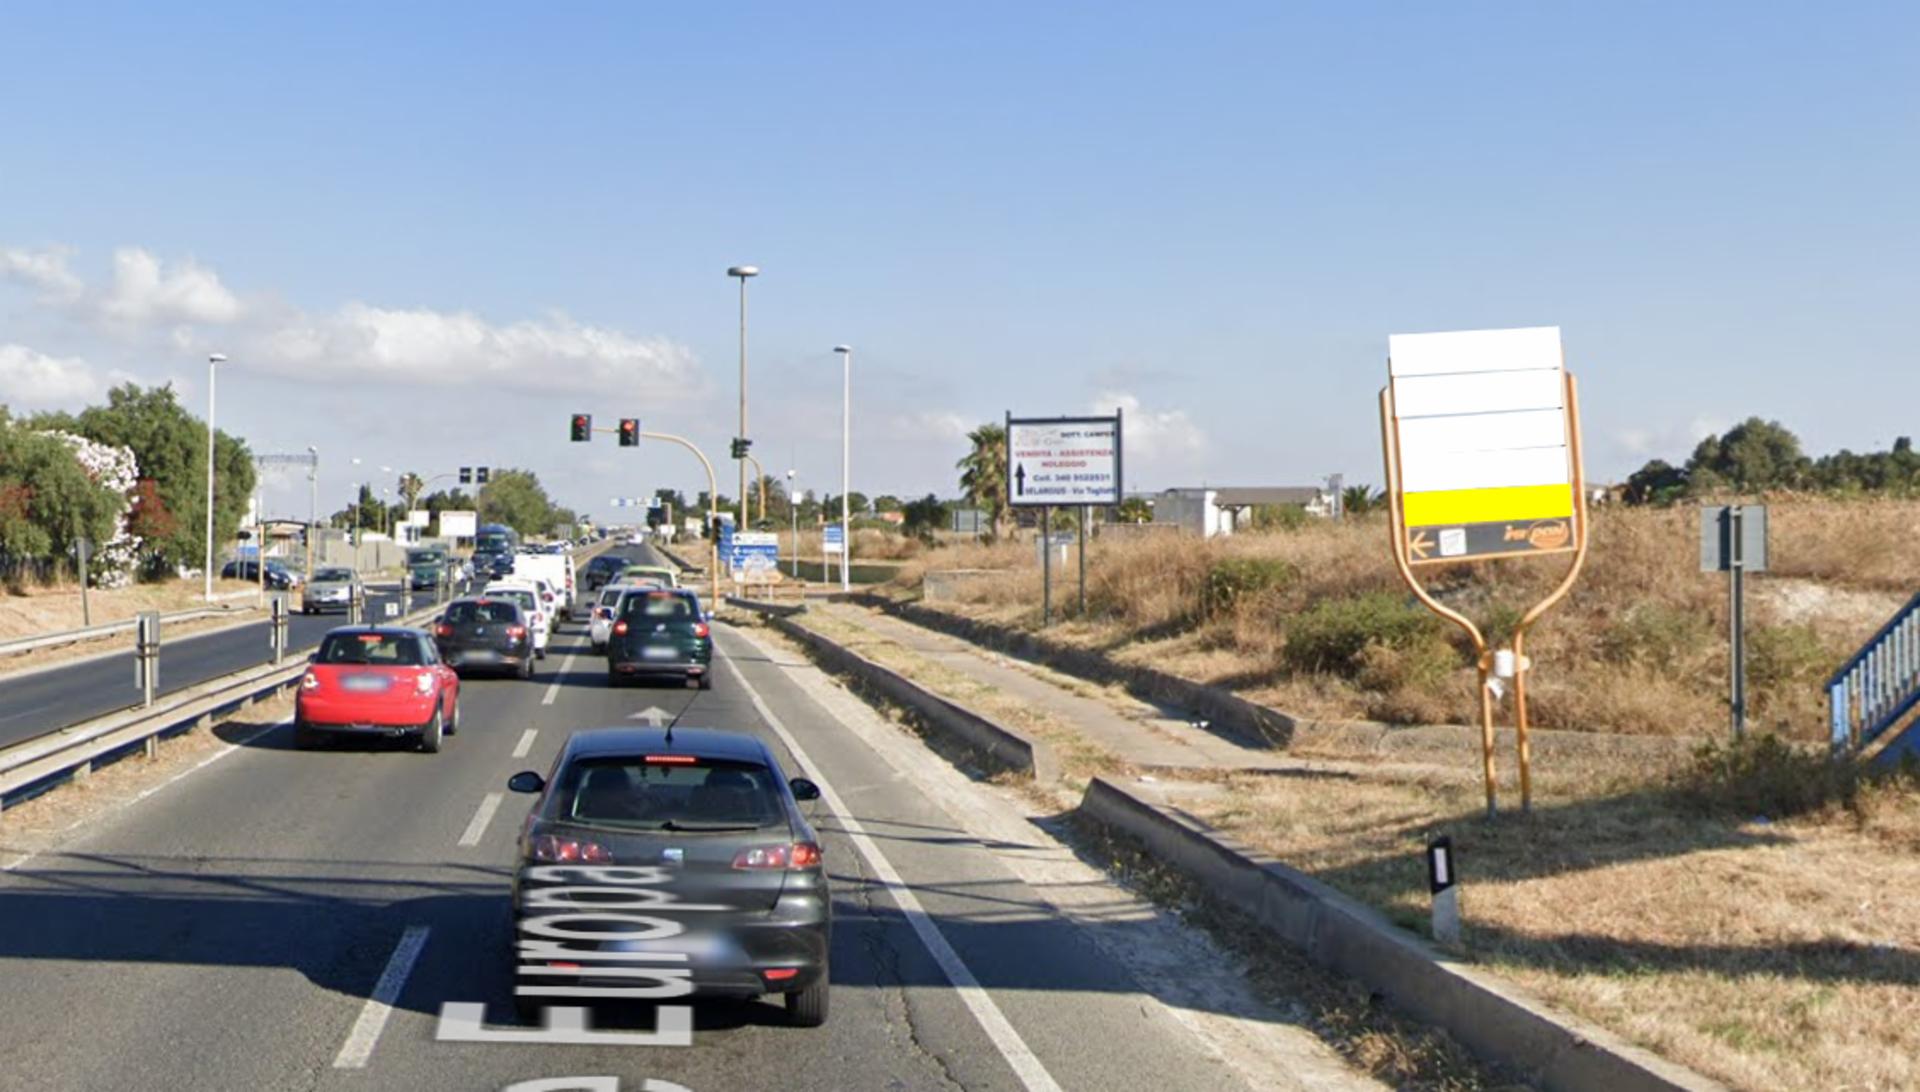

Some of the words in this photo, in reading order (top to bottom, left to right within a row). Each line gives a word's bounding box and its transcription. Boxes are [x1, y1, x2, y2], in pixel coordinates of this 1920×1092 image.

[1015, 450, 1052, 458] VENDITA
[1059, 449, 1114, 457] ASSISTENZA
[1041, 460, 1087, 468] NOLEGGIO
